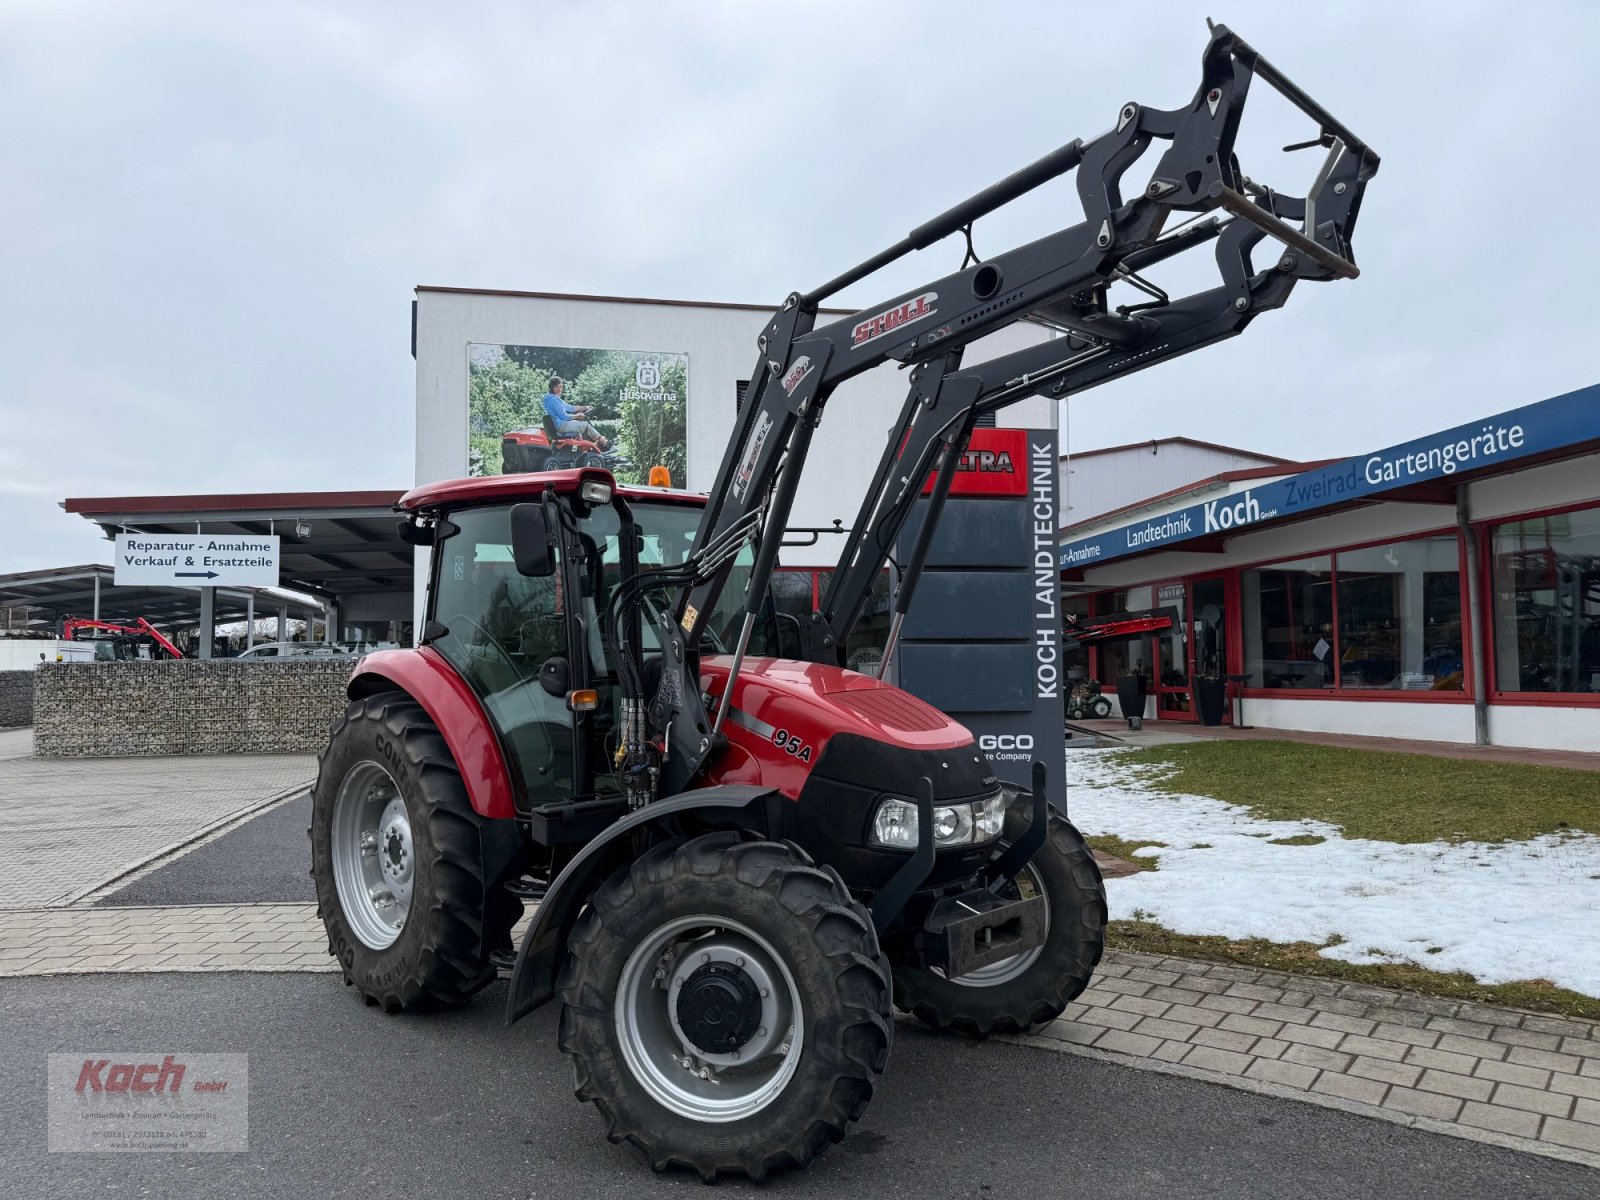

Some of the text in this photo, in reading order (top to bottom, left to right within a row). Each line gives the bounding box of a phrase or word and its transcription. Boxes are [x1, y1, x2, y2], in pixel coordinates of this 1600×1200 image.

[854, 296, 931, 344] STOLL
[619, 388, 677, 402] Husqvarna
[1059, 544, 1100, 565] ur-Annahme
[1126, 513, 1192, 548] Landtechnik
[1203, 490, 1260, 533] Koch
[1260, 508, 1278, 519] GmbH
[1365, 424, 1524, 485] Gartengeräte
[127, 540, 195, 553] Reparatur
[207, 541, 271, 552] Annahme
[124, 555, 273, 567] Verkauf & Ersatzteile
[1032, 443, 1057, 698] KOCH LANDTECHNIK
[773, 728, 812, 763] 95A
[979, 734, 1034, 750] GCO
[996, 752, 1032, 762] Company
